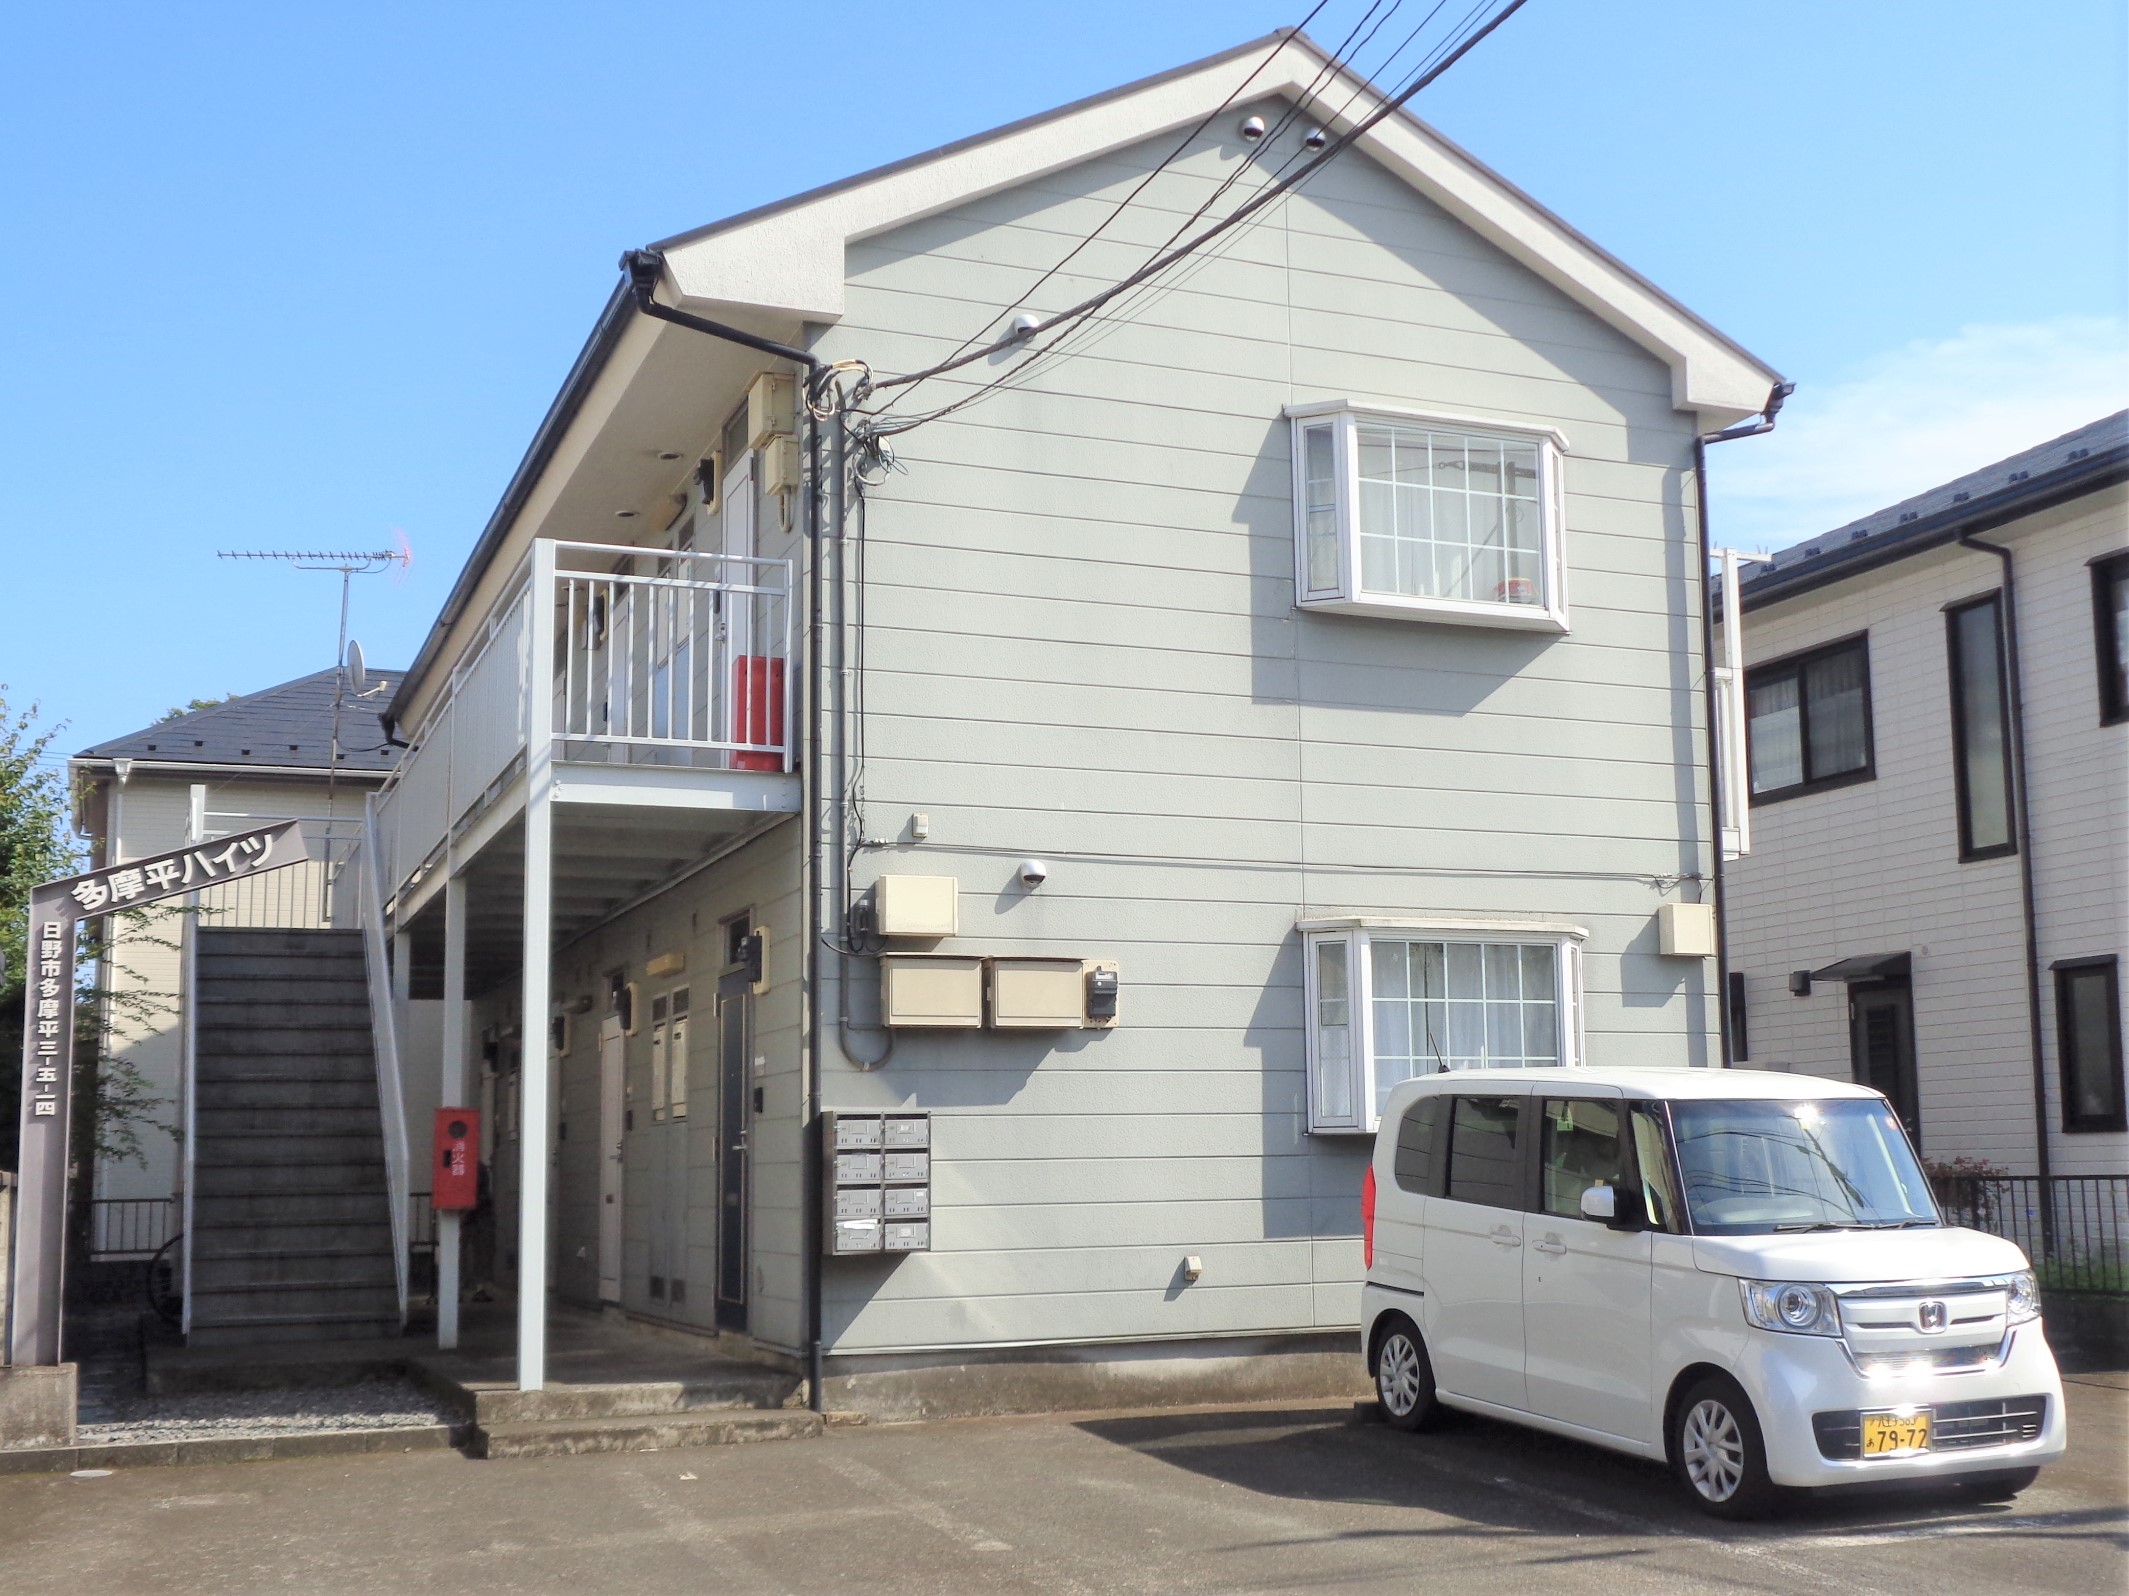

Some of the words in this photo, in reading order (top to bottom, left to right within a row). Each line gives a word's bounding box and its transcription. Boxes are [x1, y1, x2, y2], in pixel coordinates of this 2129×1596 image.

[71, 834, 273, 911] 多摩平ハイツ
[452, 1141, 465, 1175] 消火器
[1877, 1428, 1928, 1452] 79-72
